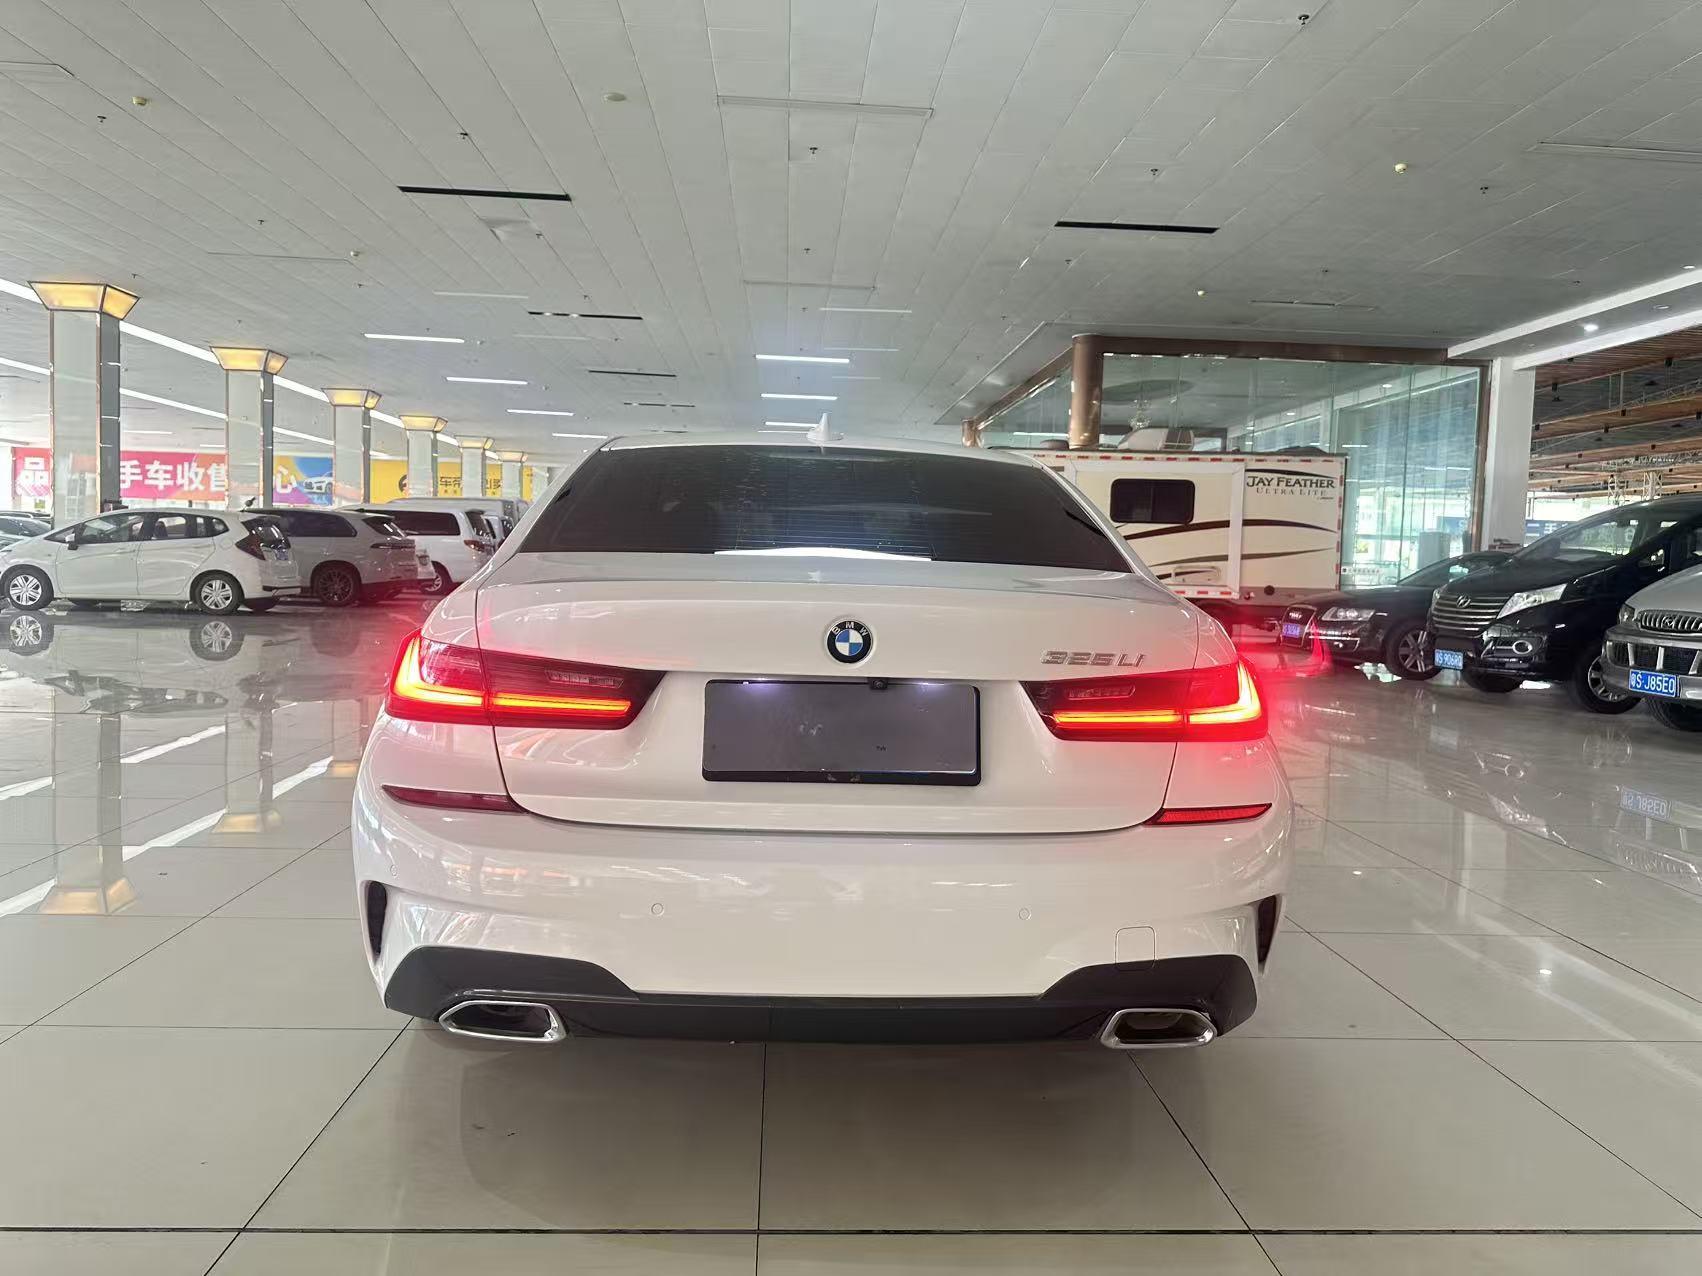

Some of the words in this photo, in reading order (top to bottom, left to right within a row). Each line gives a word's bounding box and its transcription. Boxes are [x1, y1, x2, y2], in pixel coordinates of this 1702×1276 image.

[272, 464, 299, 494] 心
[1246, 475, 1274, 488] JAY
[1276, 476, 1336, 489] FEATHER
